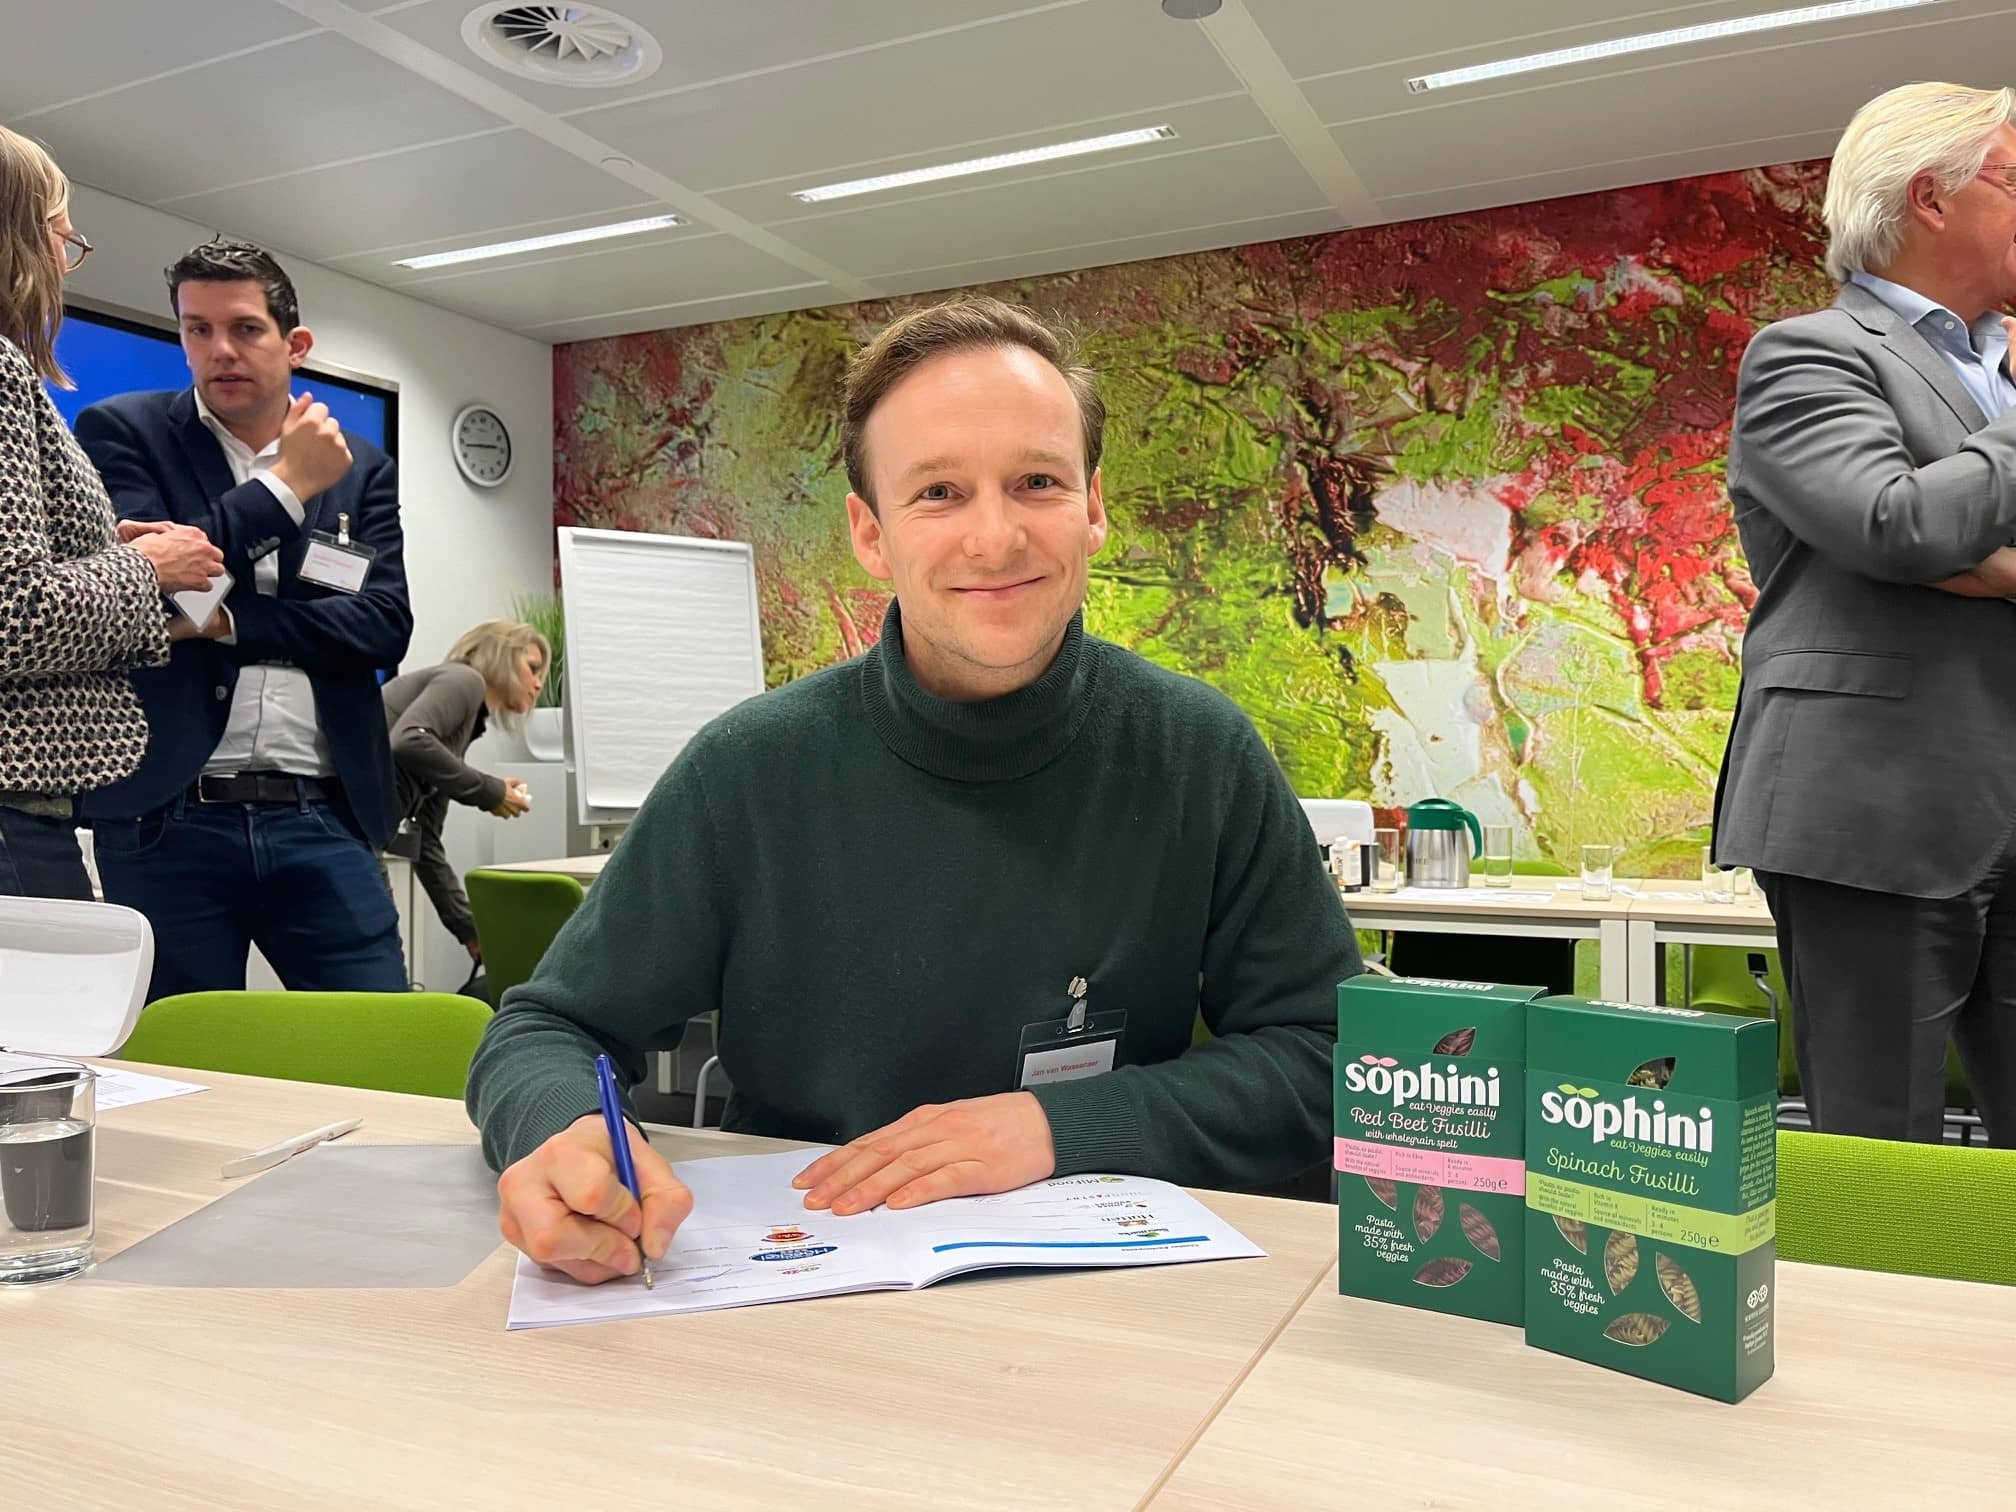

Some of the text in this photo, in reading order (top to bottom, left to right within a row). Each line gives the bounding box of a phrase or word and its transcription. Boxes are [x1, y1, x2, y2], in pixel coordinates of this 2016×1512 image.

[1345, 1060, 1500, 1107] sophini
[1409, 1102, 1424, 1111] eat
[1467, 1107, 1497, 1120] easily
[1350, 1107, 1491, 1139] Red Beet Fusilli
[1541, 1090, 1713, 1153] sophini
[1365, 1129, 1458, 1150] with wholegrain spelt
[1610, 1138, 1628, 1150] eat
[1675, 1150, 1709, 1168] easily
[1546, 1148, 1700, 1196] Spinach Fusilli
[1473, 1176, 1497, 1191] 250g
[1366, 1214, 1396, 1229] Pasta
[1355, 1224, 1405, 1240] made with
[1680, 1229, 1707, 1248] 250g
[1363, 1235, 1415, 1253] 35% fresh
[1376, 1251, 1409, 1263] veggies
[1553, 1258, 1584, 1276] Pasta
[1540, 1266, 1594, 1290] made with
[1549, 1280, 1606, 1305] 35% fresh
[1563, 1299, 1599, 1315] veggies
